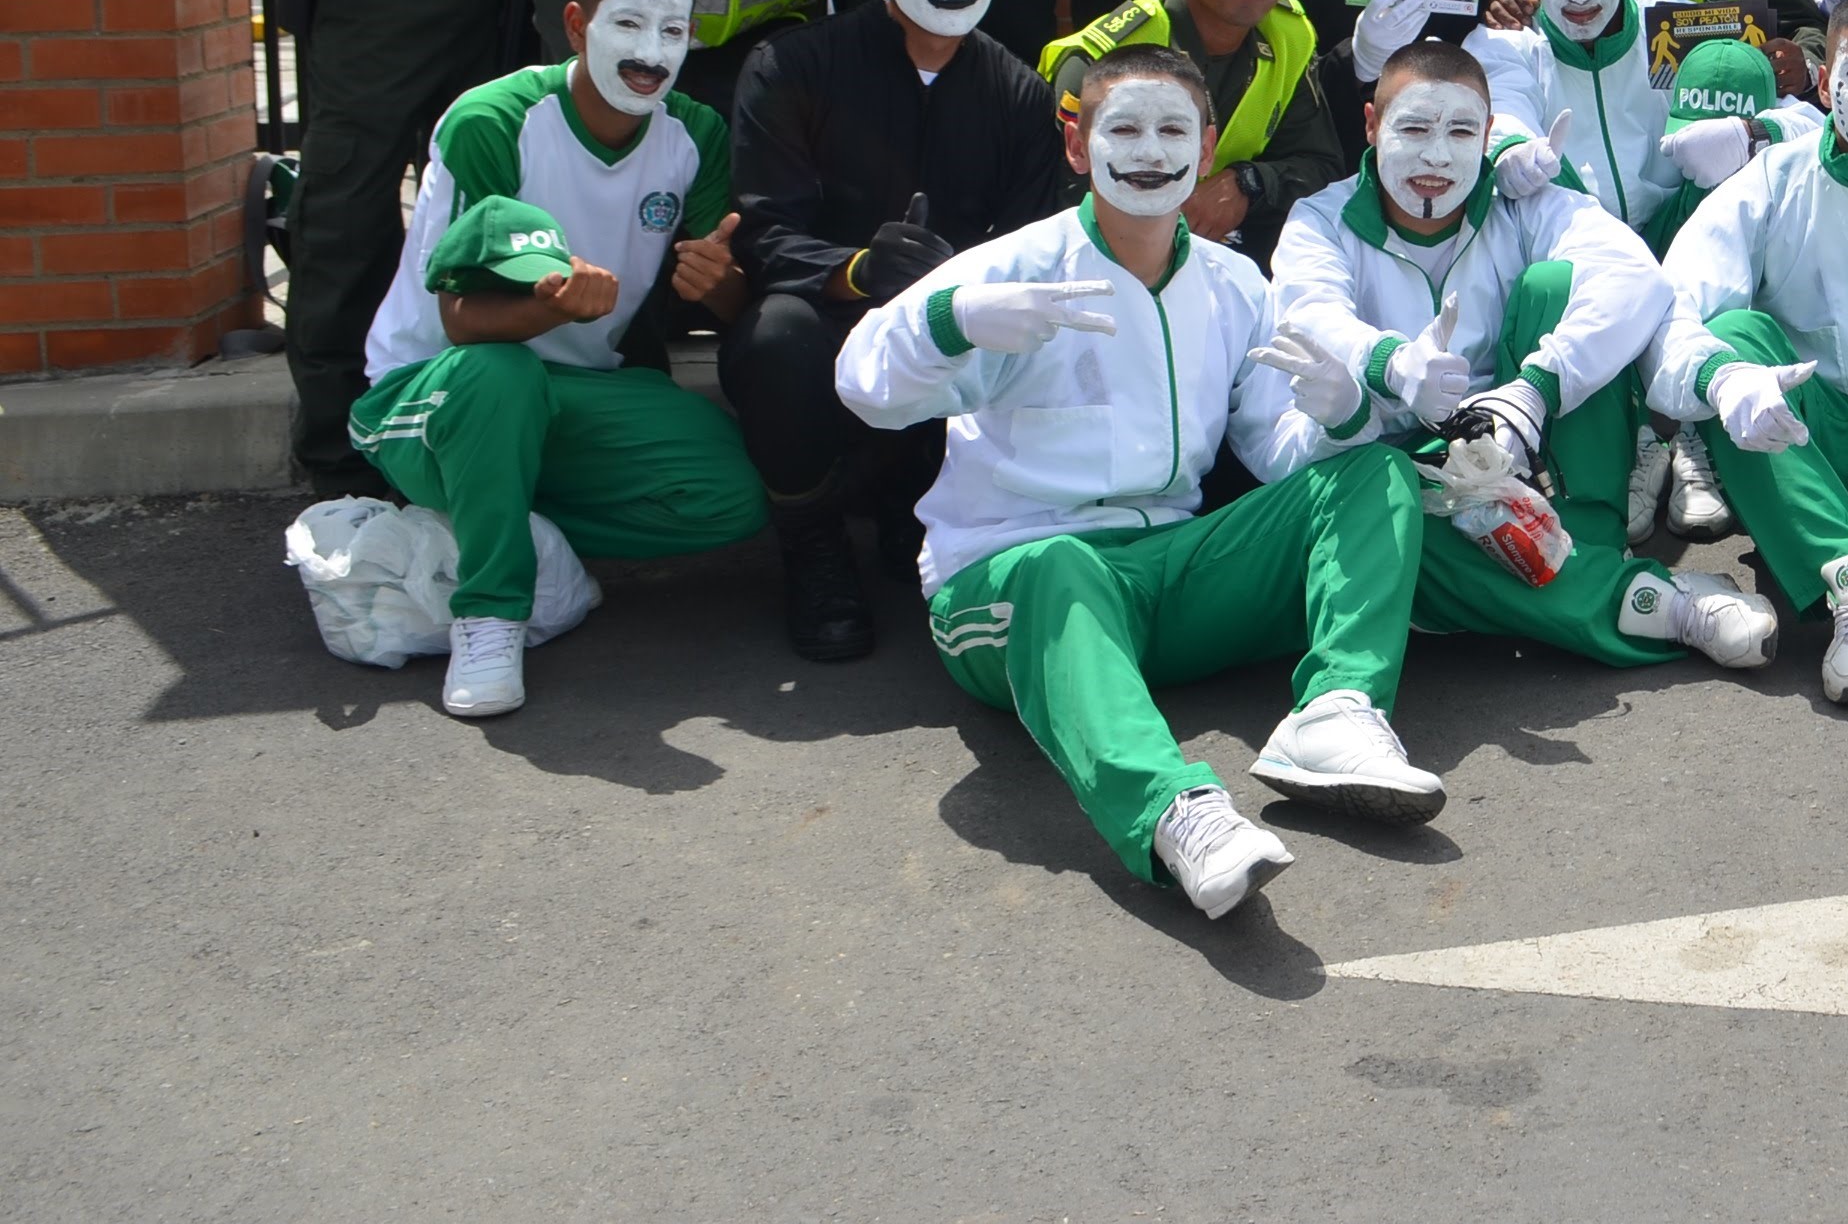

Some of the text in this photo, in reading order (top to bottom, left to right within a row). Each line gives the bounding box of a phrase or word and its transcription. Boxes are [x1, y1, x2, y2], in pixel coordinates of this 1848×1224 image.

[1675, 16, 1696, 27] SOY
[1675, 23, 1738, 34] RESPONSABLE
[1678, 87, 1756, 117] POLICIA
[1501, 533, 1533, 574] Siempre
